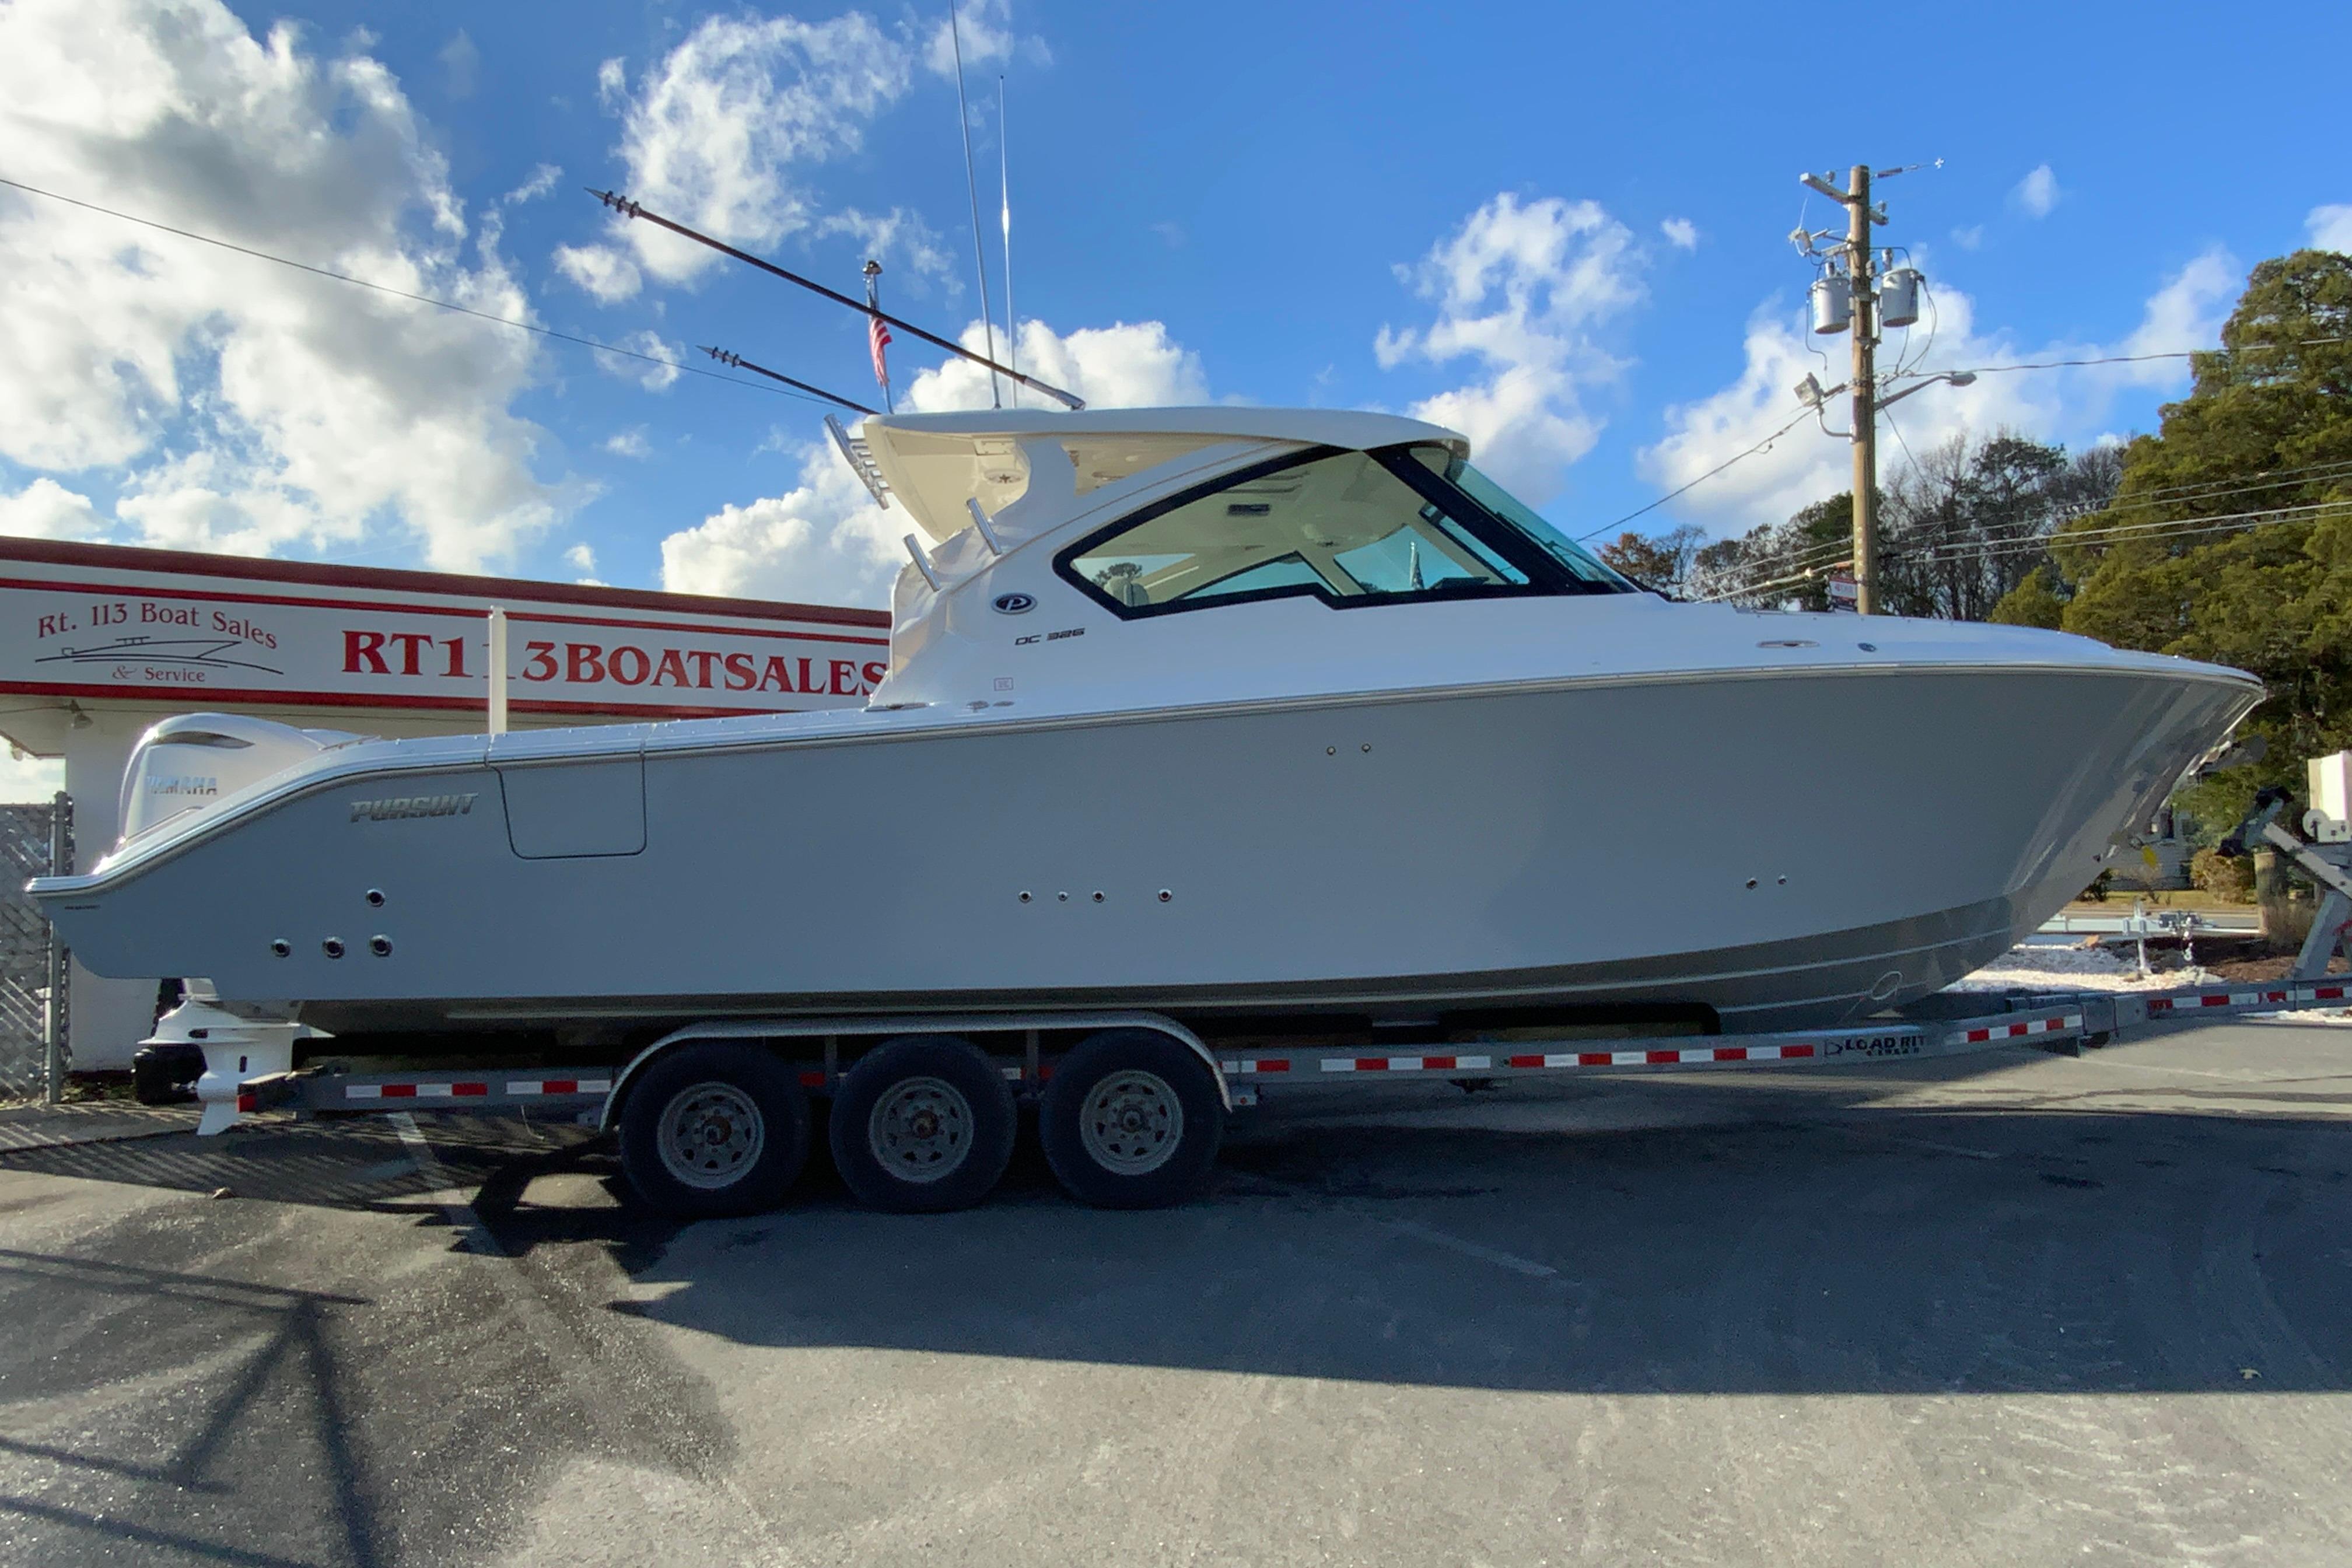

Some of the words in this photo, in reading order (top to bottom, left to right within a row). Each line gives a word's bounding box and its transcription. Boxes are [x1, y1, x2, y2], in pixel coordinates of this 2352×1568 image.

[38, 612, 77, 638] Rt.
[92, 603, 127, 626] 113
[141, 603, 200, 626] Boat
[212, 611, 276, 649] Sales
[112, 665, 136, 679] &
[145, 666, 205, 682] Service
[342, 630, 887, 696] RT13BOATSALES
[350, 792, 480, 822] PURSUIT
[1845, 1037, 1896, 1051] LOAD
